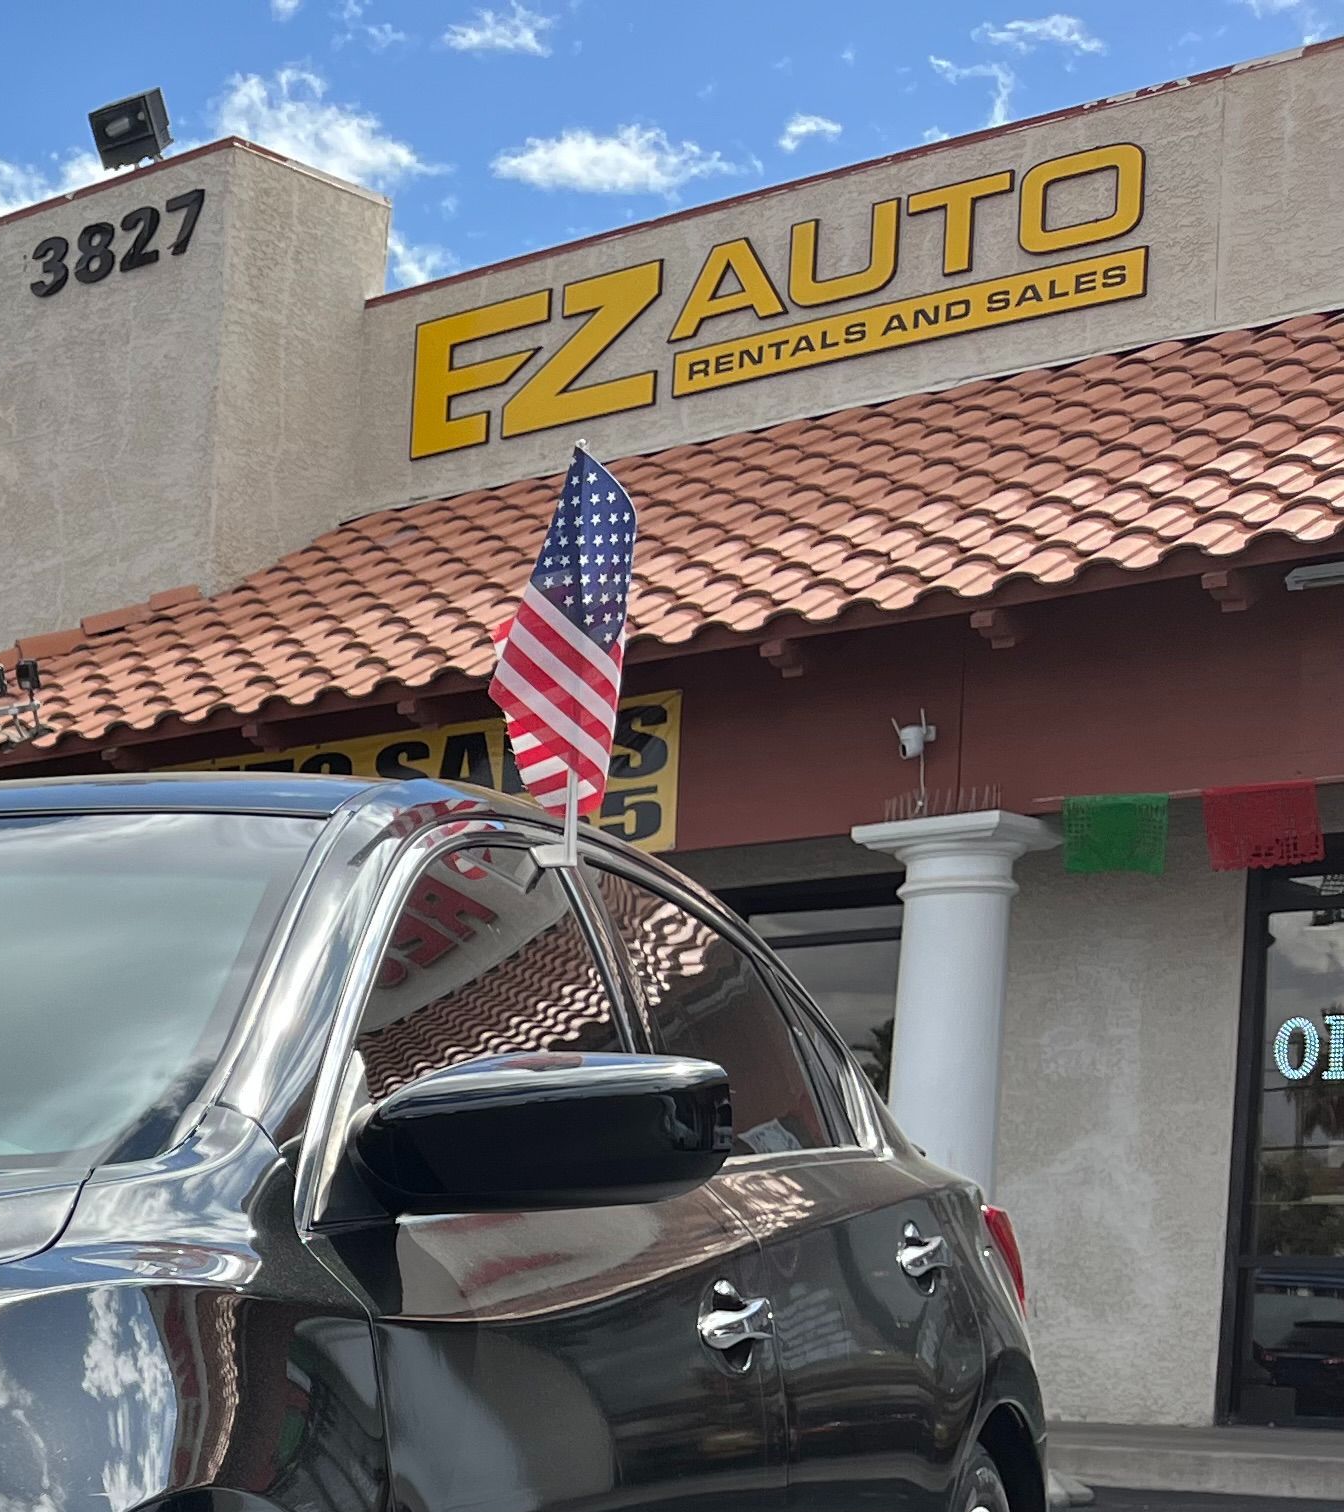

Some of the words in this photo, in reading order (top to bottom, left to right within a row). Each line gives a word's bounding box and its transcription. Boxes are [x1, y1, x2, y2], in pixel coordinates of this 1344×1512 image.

[30, 188, 206, 298] 3827
[409, 260, 665, 461] EZ
[668, 141, 1146, 343] AUTO
[687, 320, 868, 383] RENTALS
[880, 299, 971, 337] AND
[985, 264, 1128, 313] SALES
[375, 704, 669, 790] SAS
